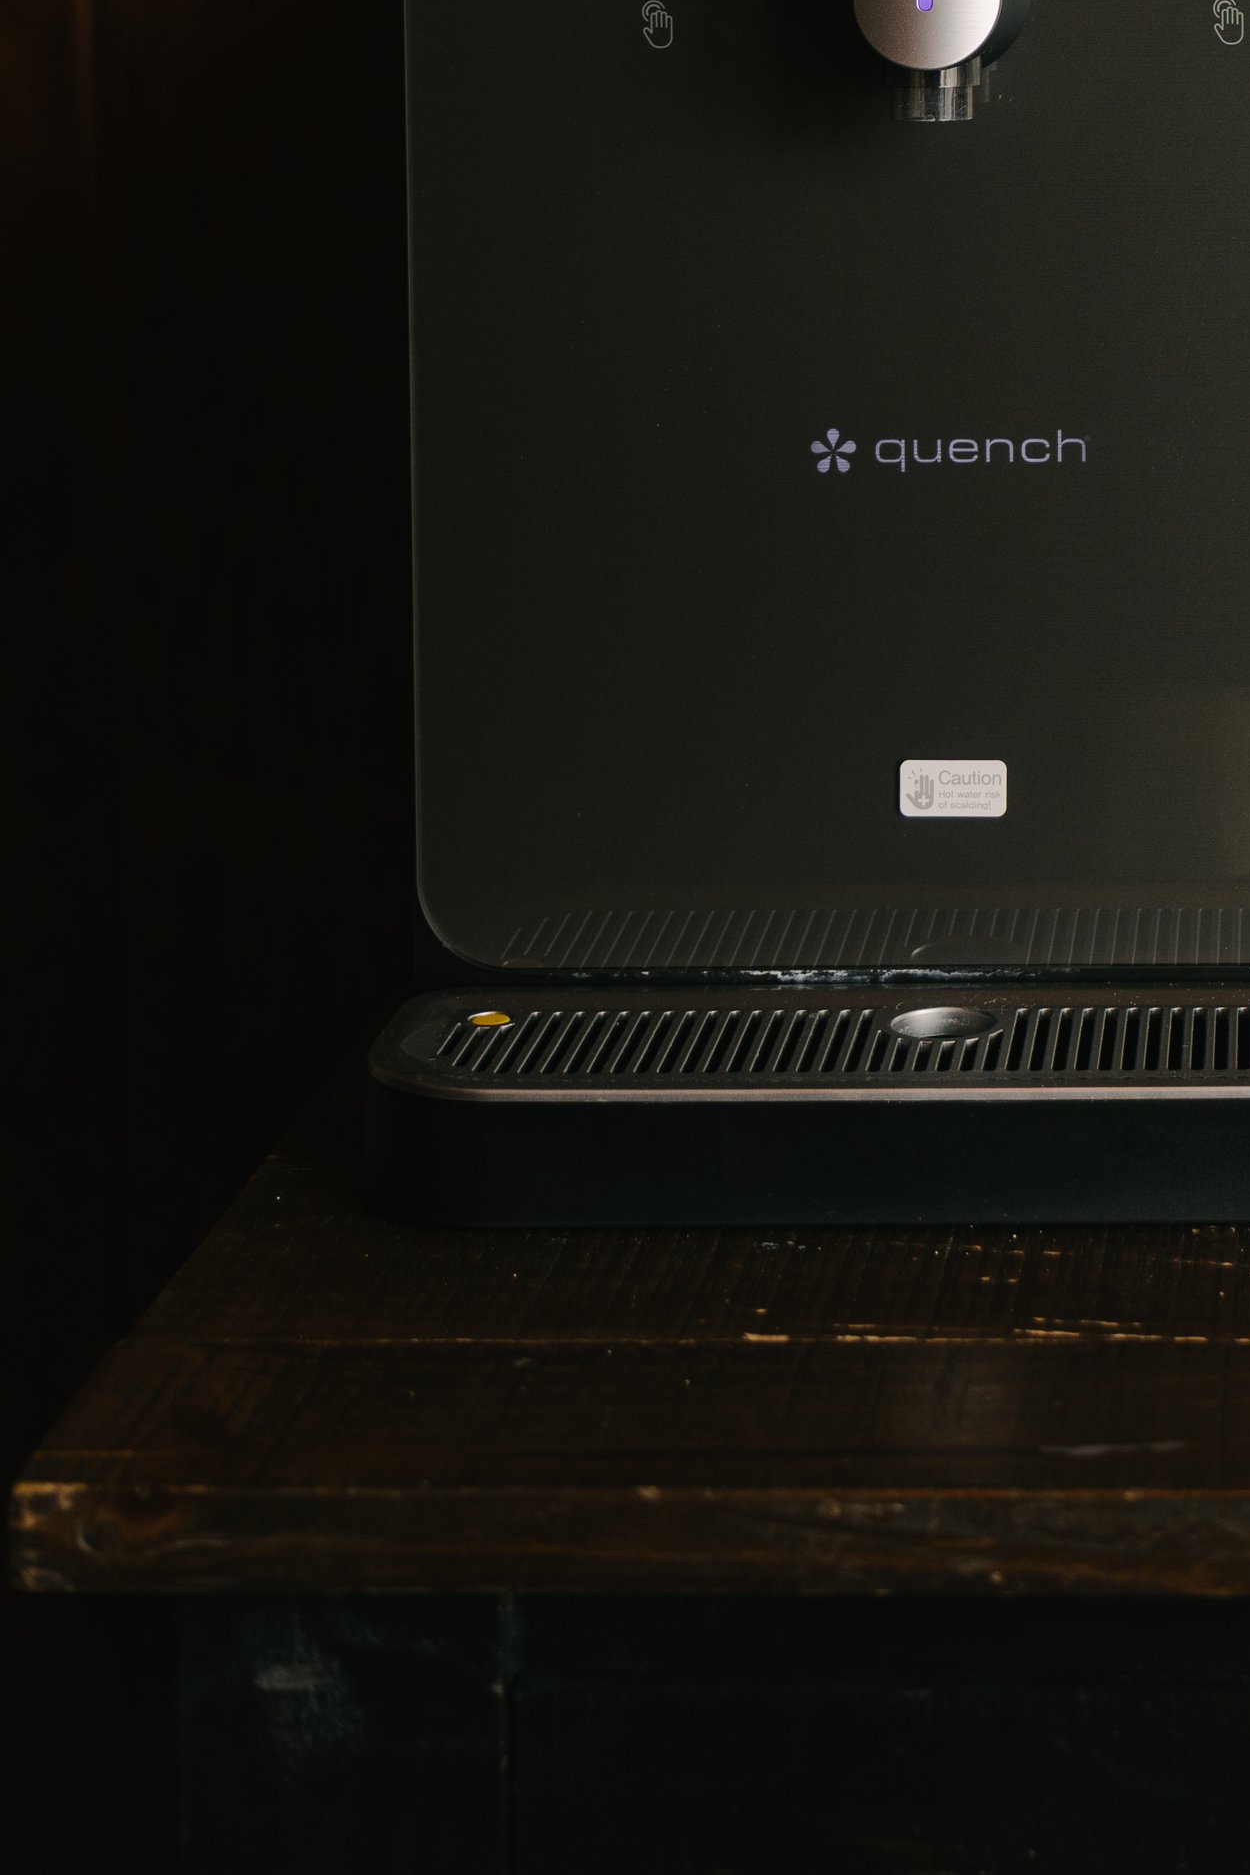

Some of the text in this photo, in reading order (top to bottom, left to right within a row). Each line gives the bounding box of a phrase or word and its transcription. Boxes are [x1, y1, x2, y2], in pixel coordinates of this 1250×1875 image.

[875, 429, 1087, 472] quench
[938, 769, 1002, 786] Caution
[938, 790, 1002, 799] Hot water risk
[938, 801, 992, 811] of scalding!
